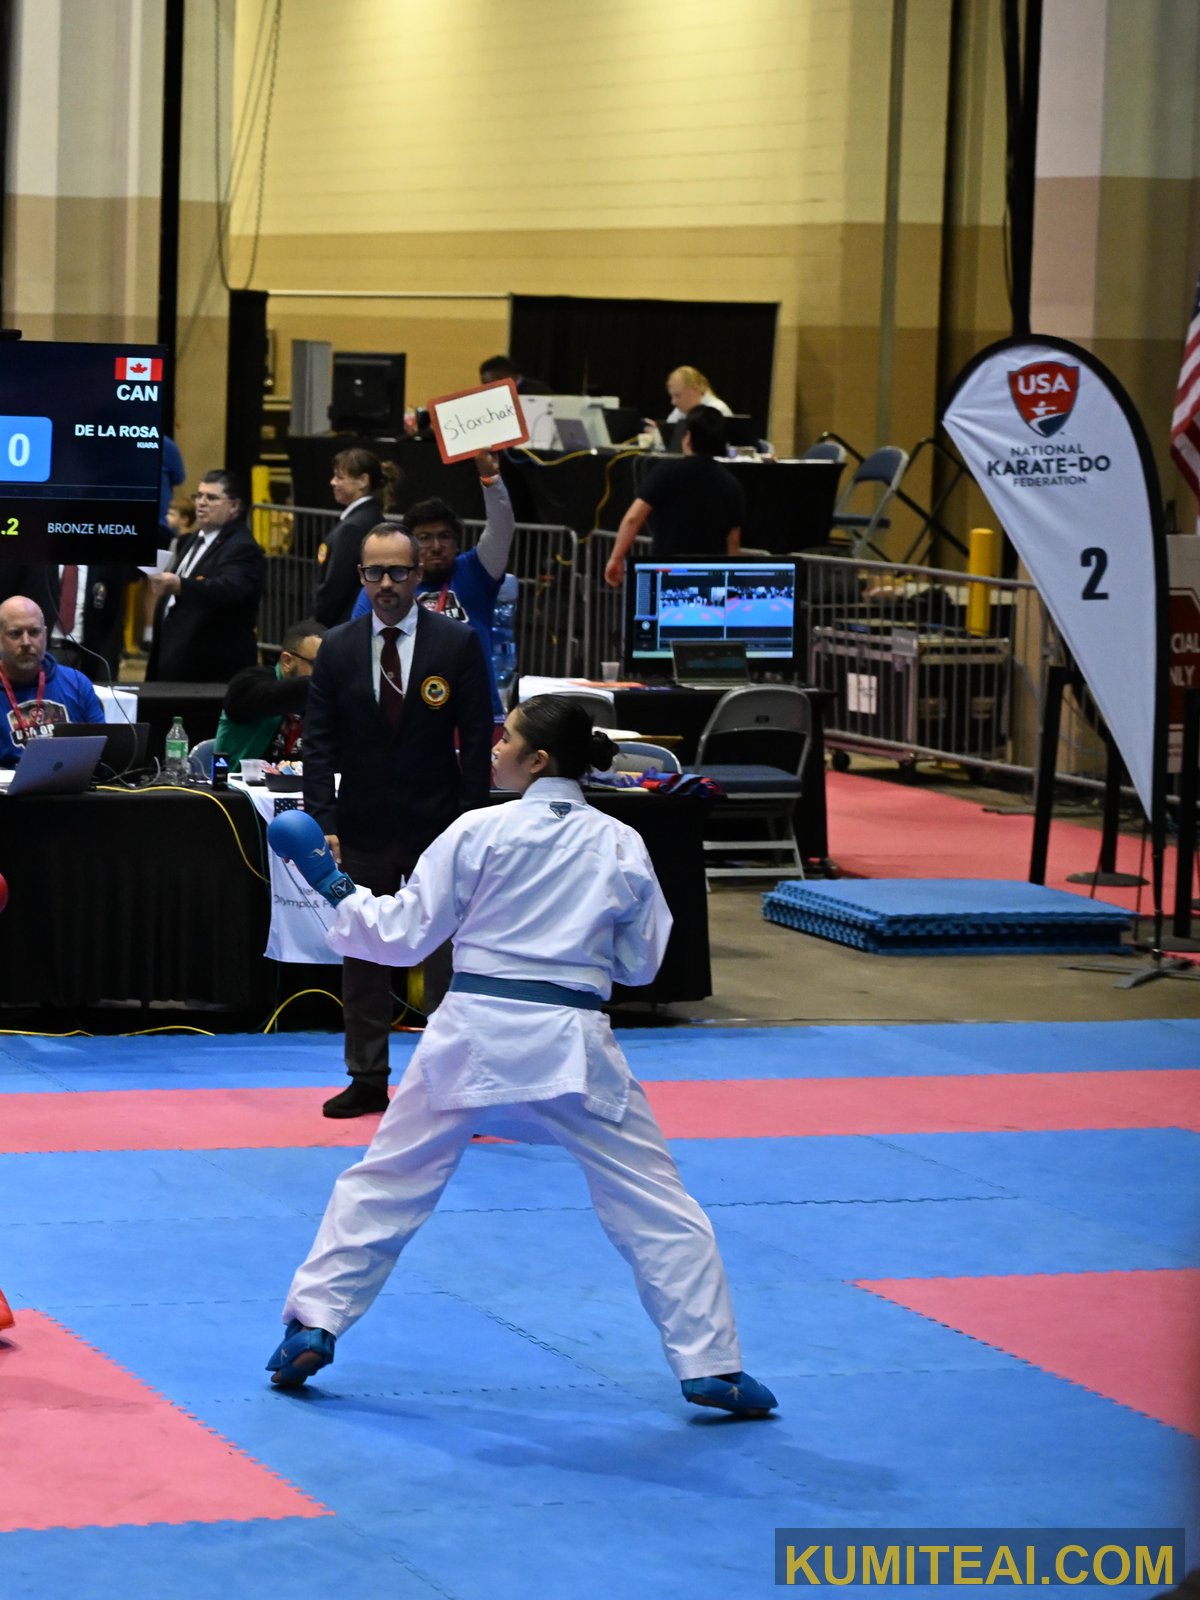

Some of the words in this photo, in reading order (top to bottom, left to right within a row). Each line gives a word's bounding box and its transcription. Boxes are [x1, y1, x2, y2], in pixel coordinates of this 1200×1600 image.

[116, 385, 159, 402] CAN
[1017, 373, 1071, 395] USA
[74, 424, 95, 436] DE
[97, 425, 117, 437] LA
[119, 426, 160, 438] ROSA
[8, 433, 31, 467] 0
[1010, 443, 1085, 456] NATIONAL
[987, 455, 1111, 477] KARATE-DO
[1013, 475, 1088, 487] FEDERATION
[47, 522, 95, 535] BRONZE
[98, 523, 138, 536] MEDAL
[1080, 546, 1109, 601] 2
[1170, 632, 1200, 654] CIAL
[1169, 665, 1196, 687] NLY
[40, 723, 55, 737] OP
